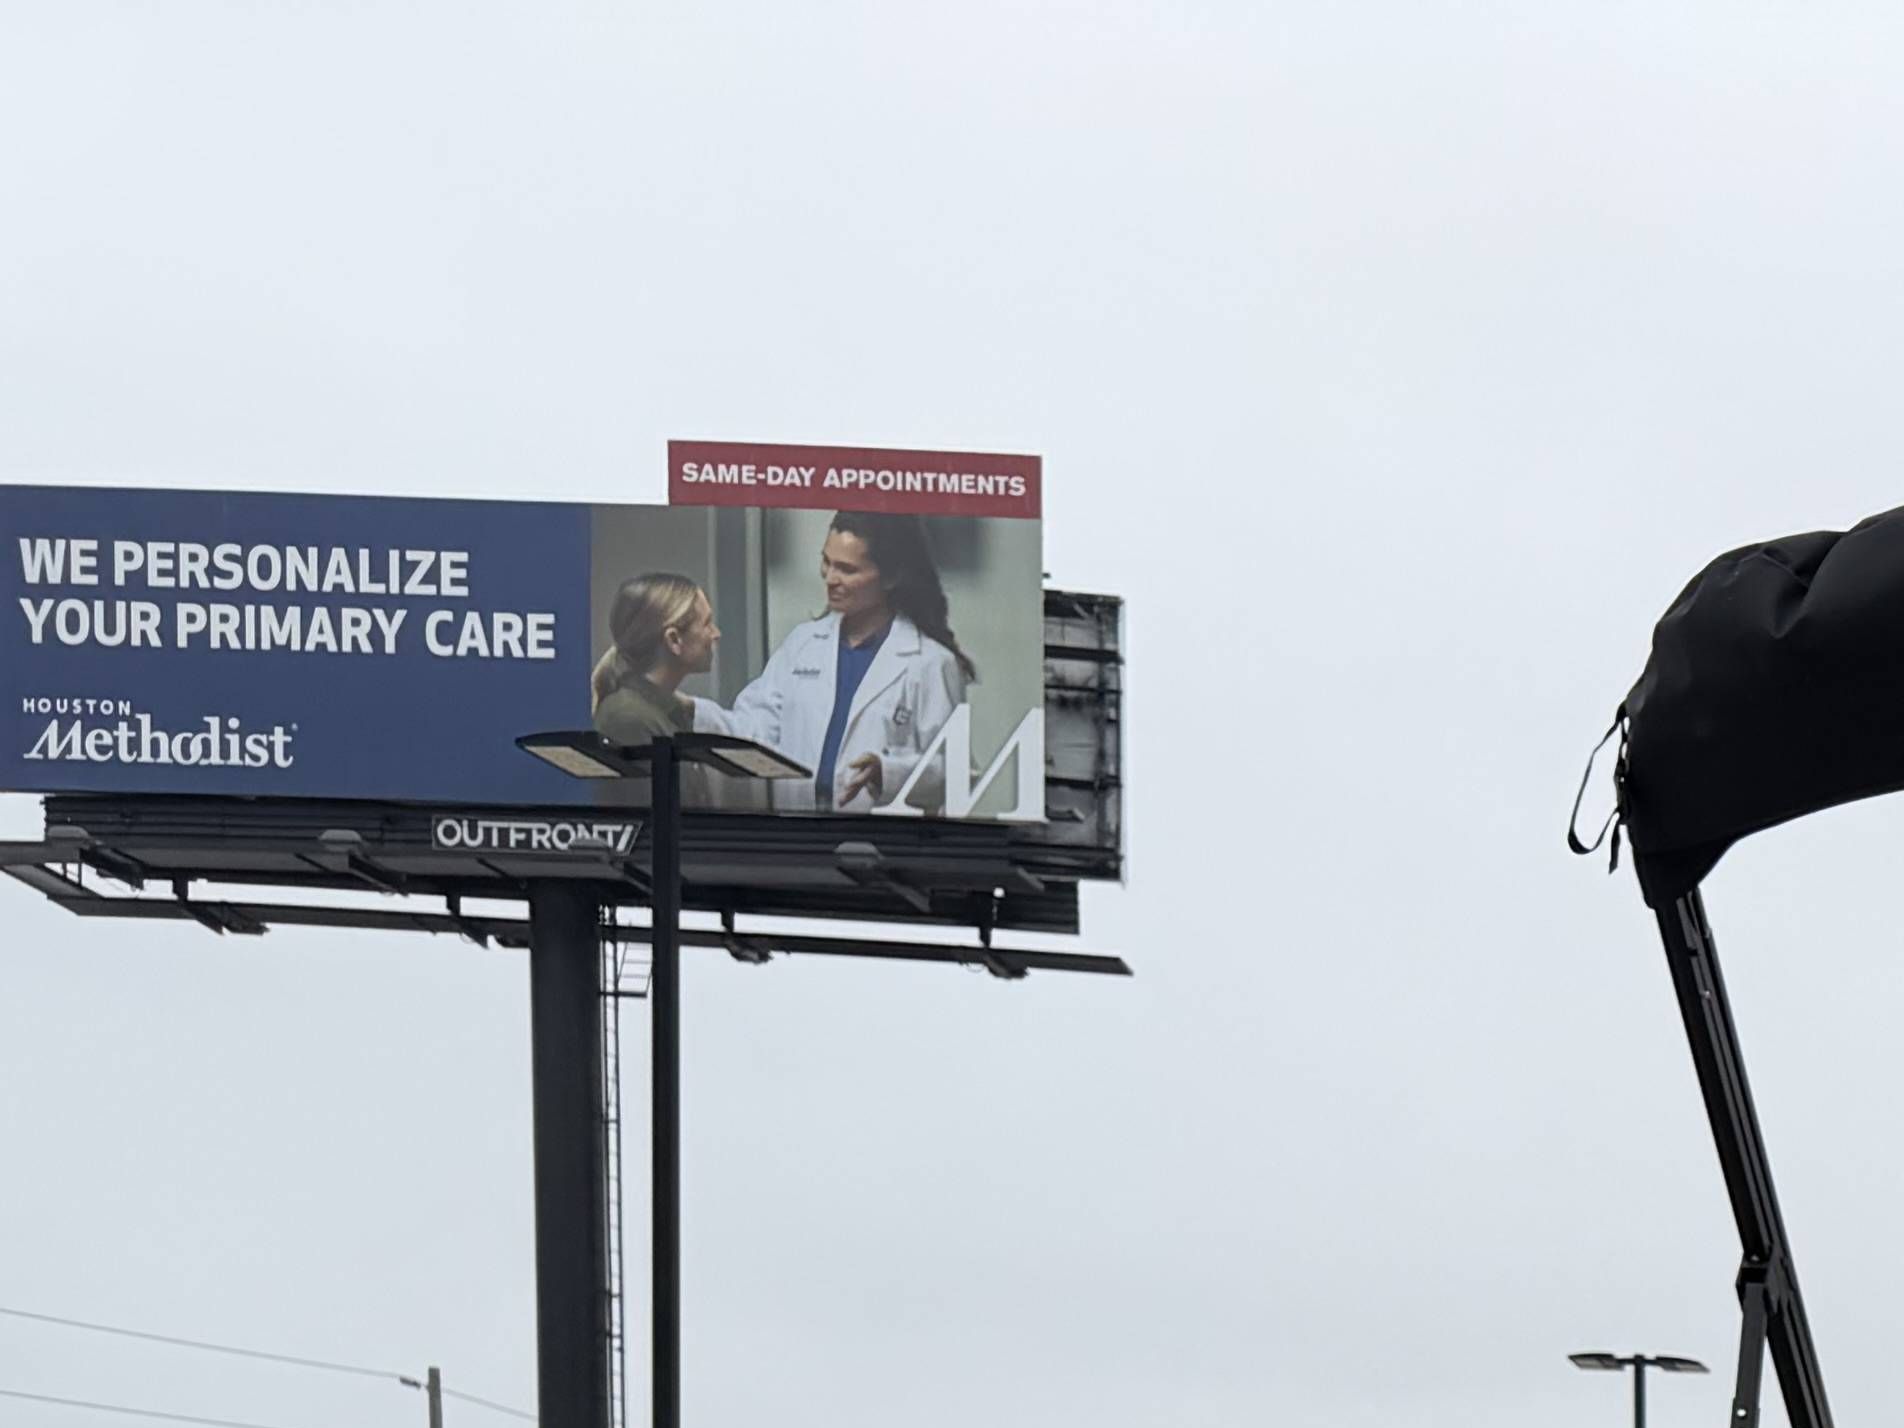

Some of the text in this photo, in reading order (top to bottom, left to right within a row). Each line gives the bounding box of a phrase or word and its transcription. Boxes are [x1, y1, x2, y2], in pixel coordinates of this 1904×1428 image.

[682, 462, 1026, 497] SAME-DAY APPOINTMENTS
[19, 537, 469, 597] WE PERSONALIZE
[20, 598, 556, 659] YOUR PRIMARY CARE
[23, 697, 131, 717] HOUSTON
[23, 714, 294, 769] Methodist
